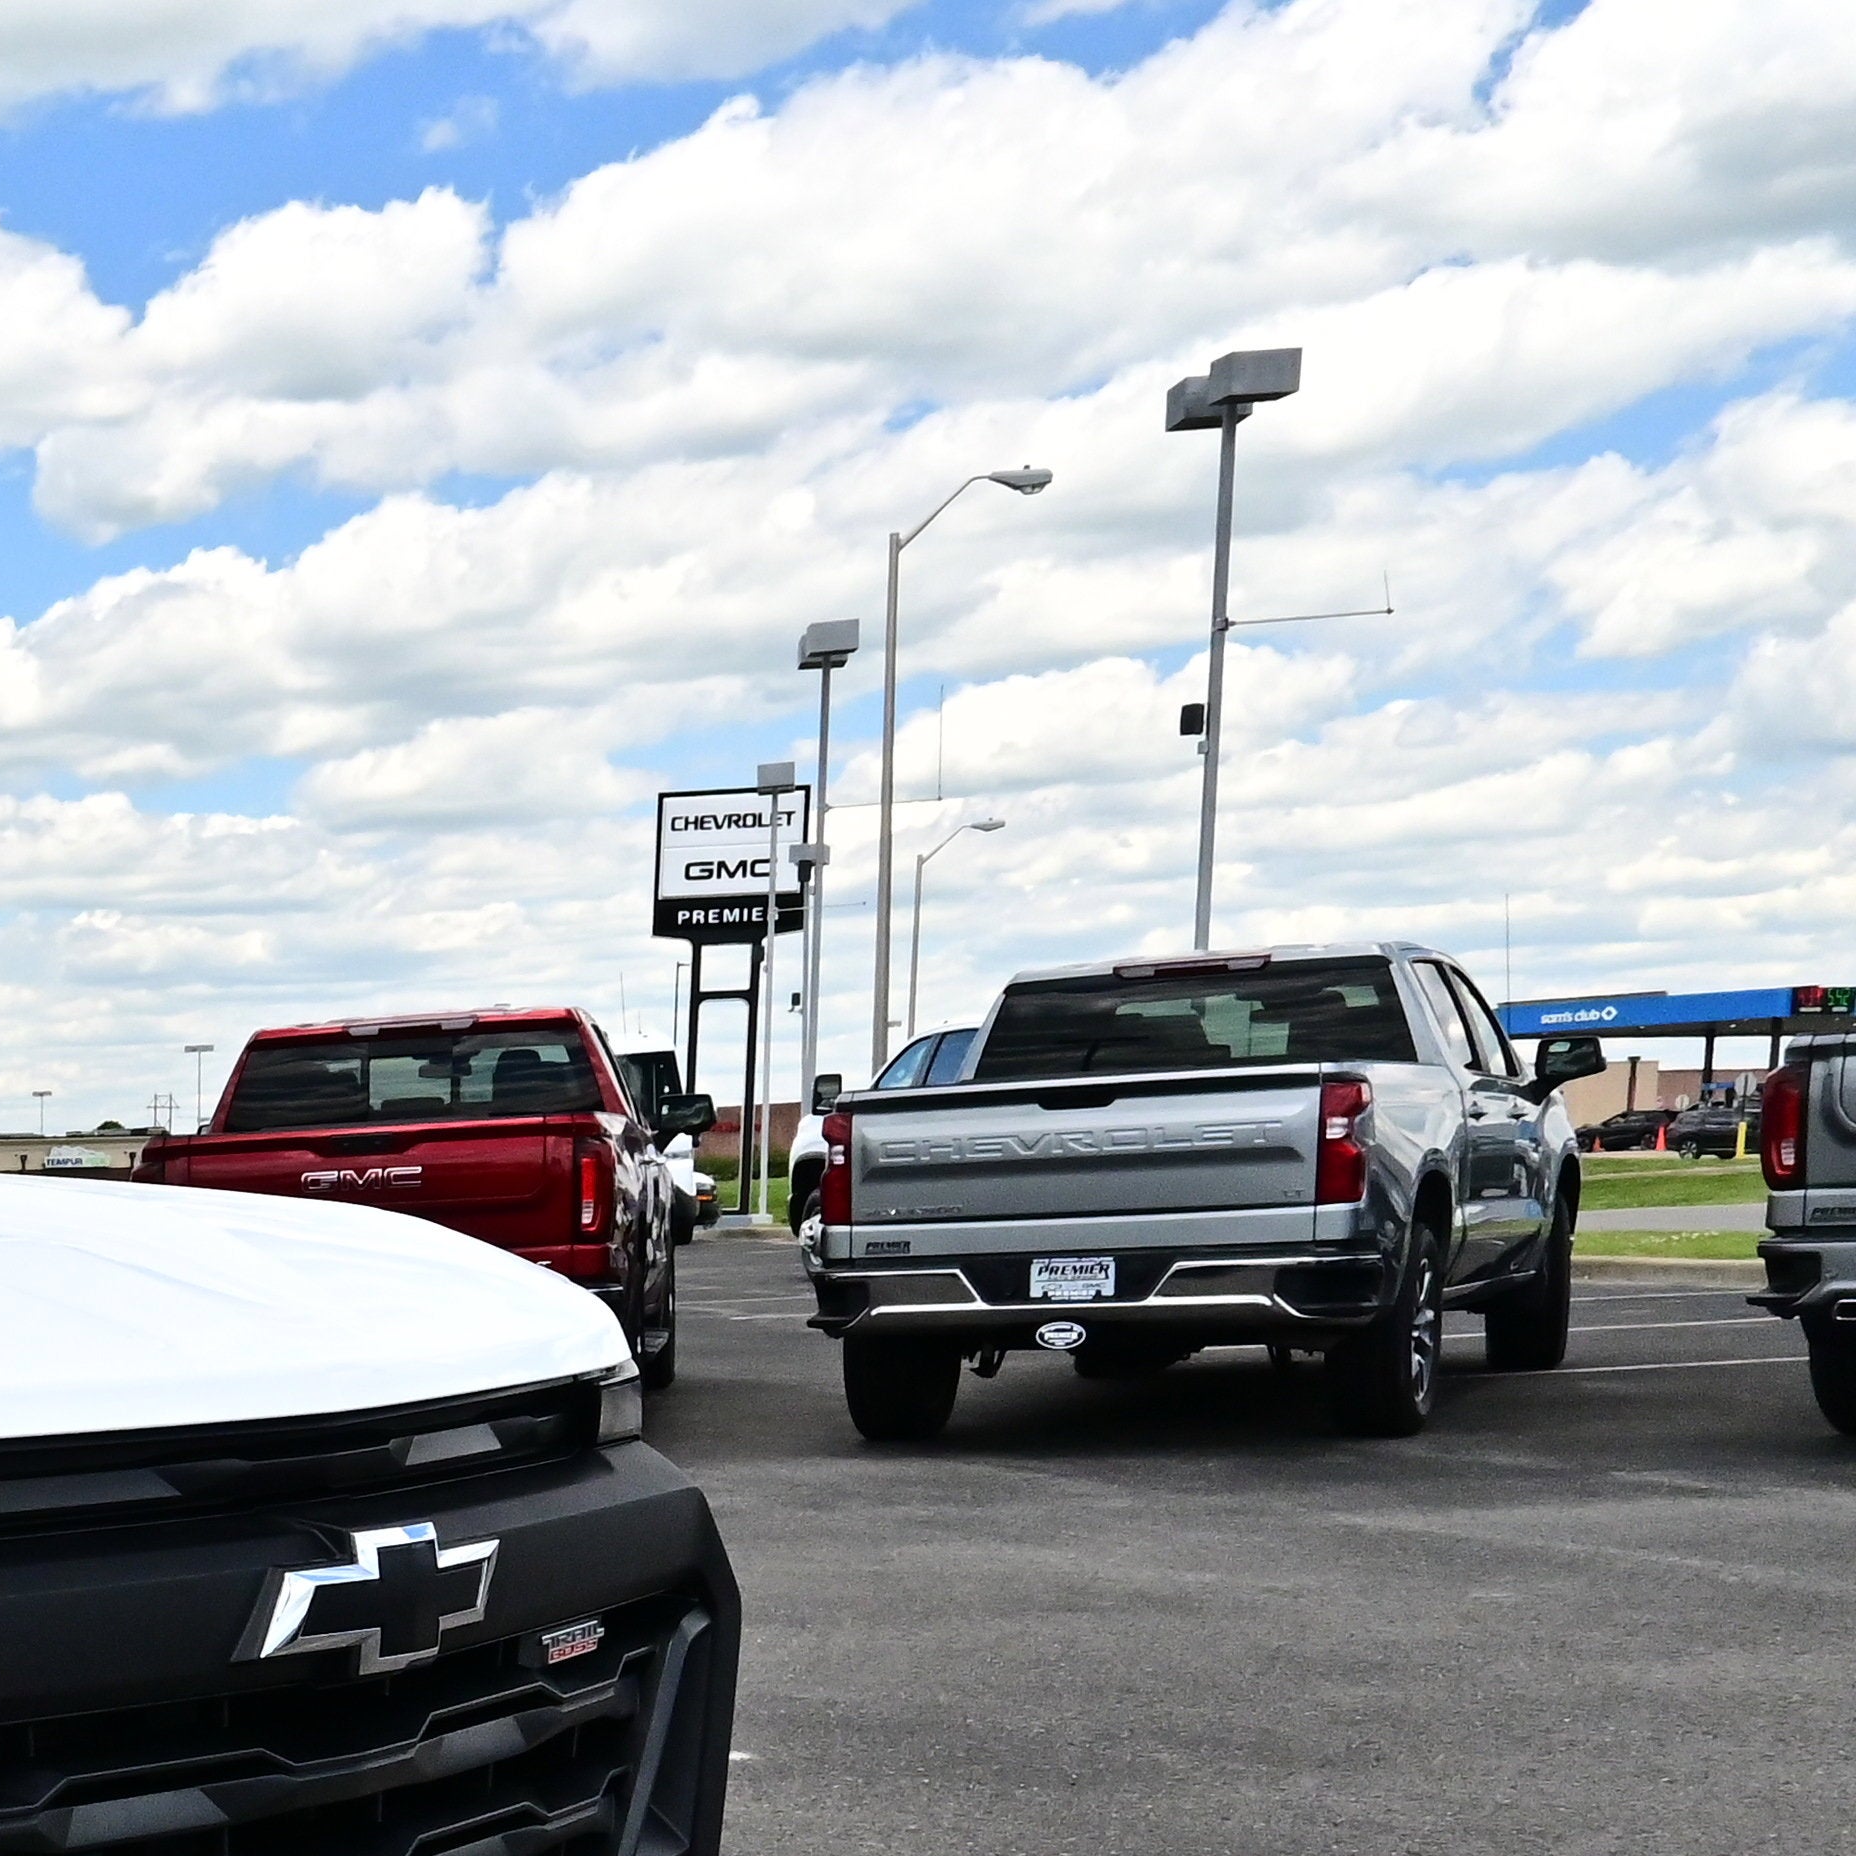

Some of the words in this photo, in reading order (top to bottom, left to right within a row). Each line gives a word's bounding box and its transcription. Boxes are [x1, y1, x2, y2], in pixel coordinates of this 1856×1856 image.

[684, 858, 776, 881] GMC
[1574, 1008, 1600, 1022] club
[878, 1120, 1283, 1163] CHEVROLET
[301, 1165, 423, 1193] GMC
[1037, 1261, 1110, 1280] PREMIER
[542, 1620, 604, 1649] TRAIL
[549, 1640, 597, 1663] BOSS
